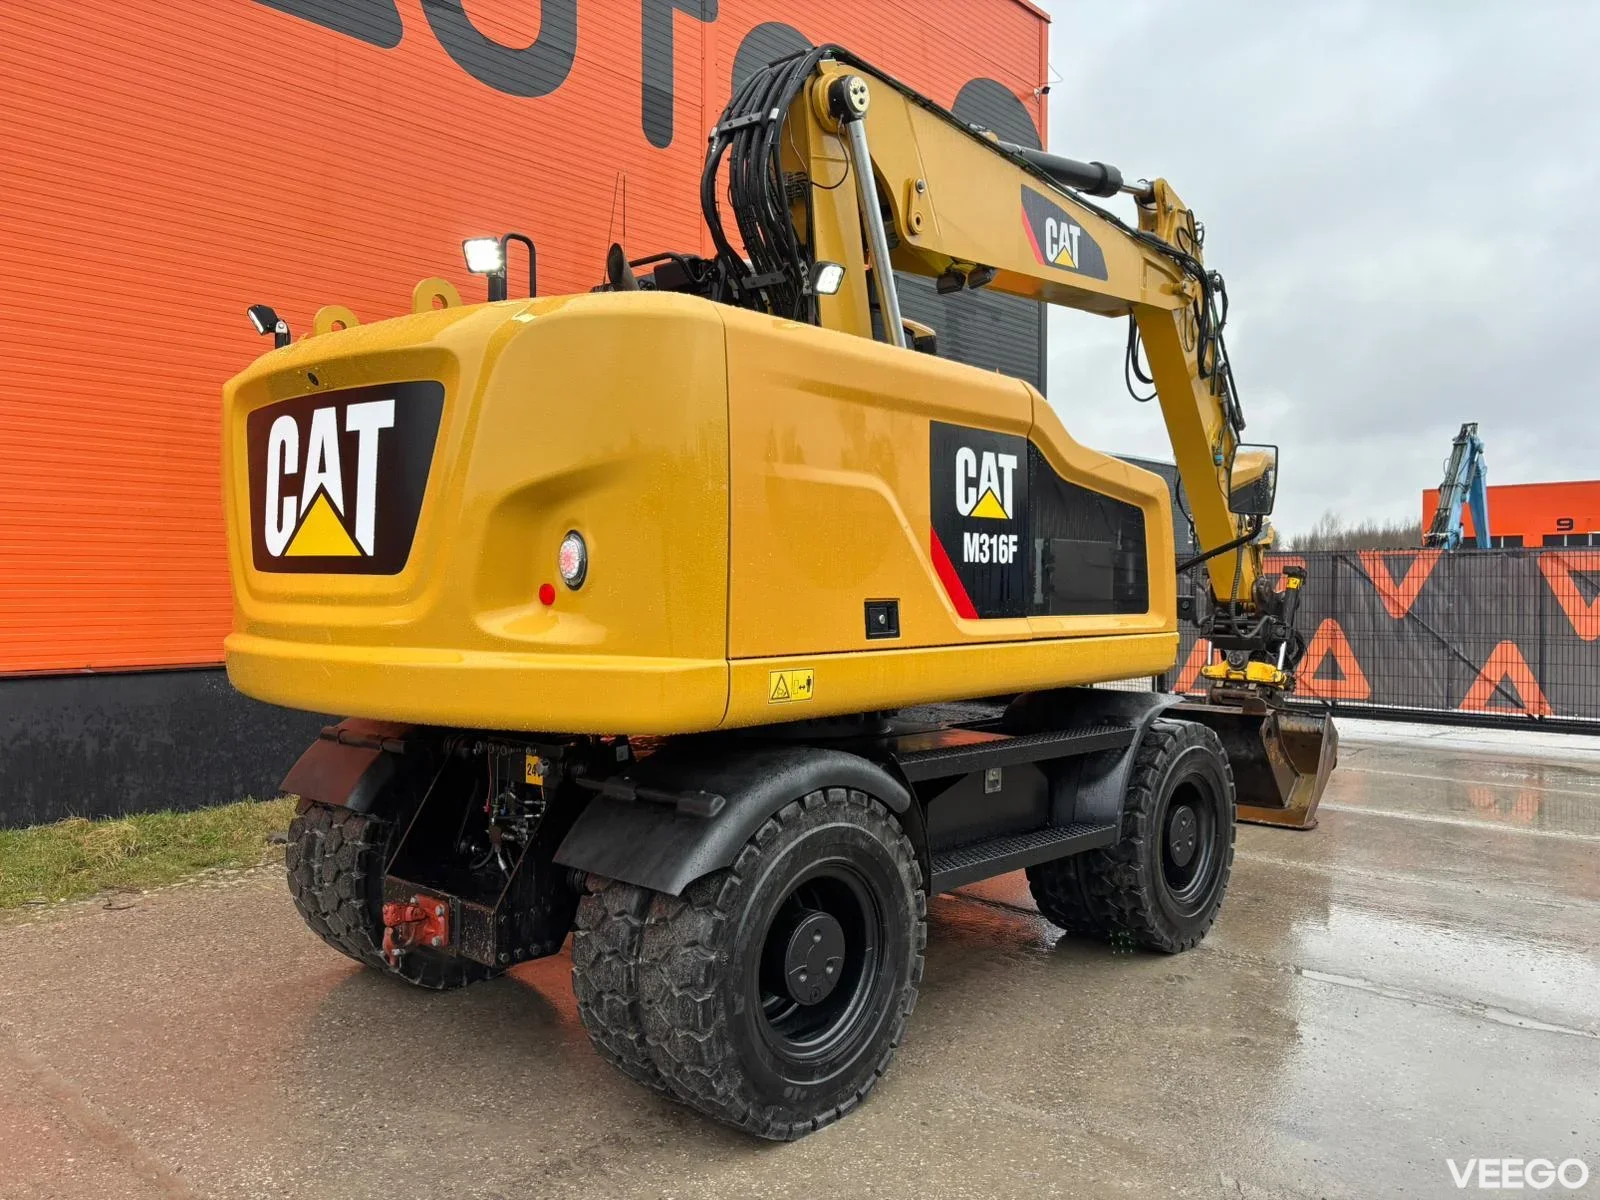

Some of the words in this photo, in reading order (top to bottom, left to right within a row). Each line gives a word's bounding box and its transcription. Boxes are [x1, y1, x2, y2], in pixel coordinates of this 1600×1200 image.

[1045, 217, 1081, 269] CAT
[265, 400, 396, 557] CAT
[955, 446, 1018, 520] CAT
[963, 532, 1018, 564] M316F
[1556, 518, 1574, 531] 9
